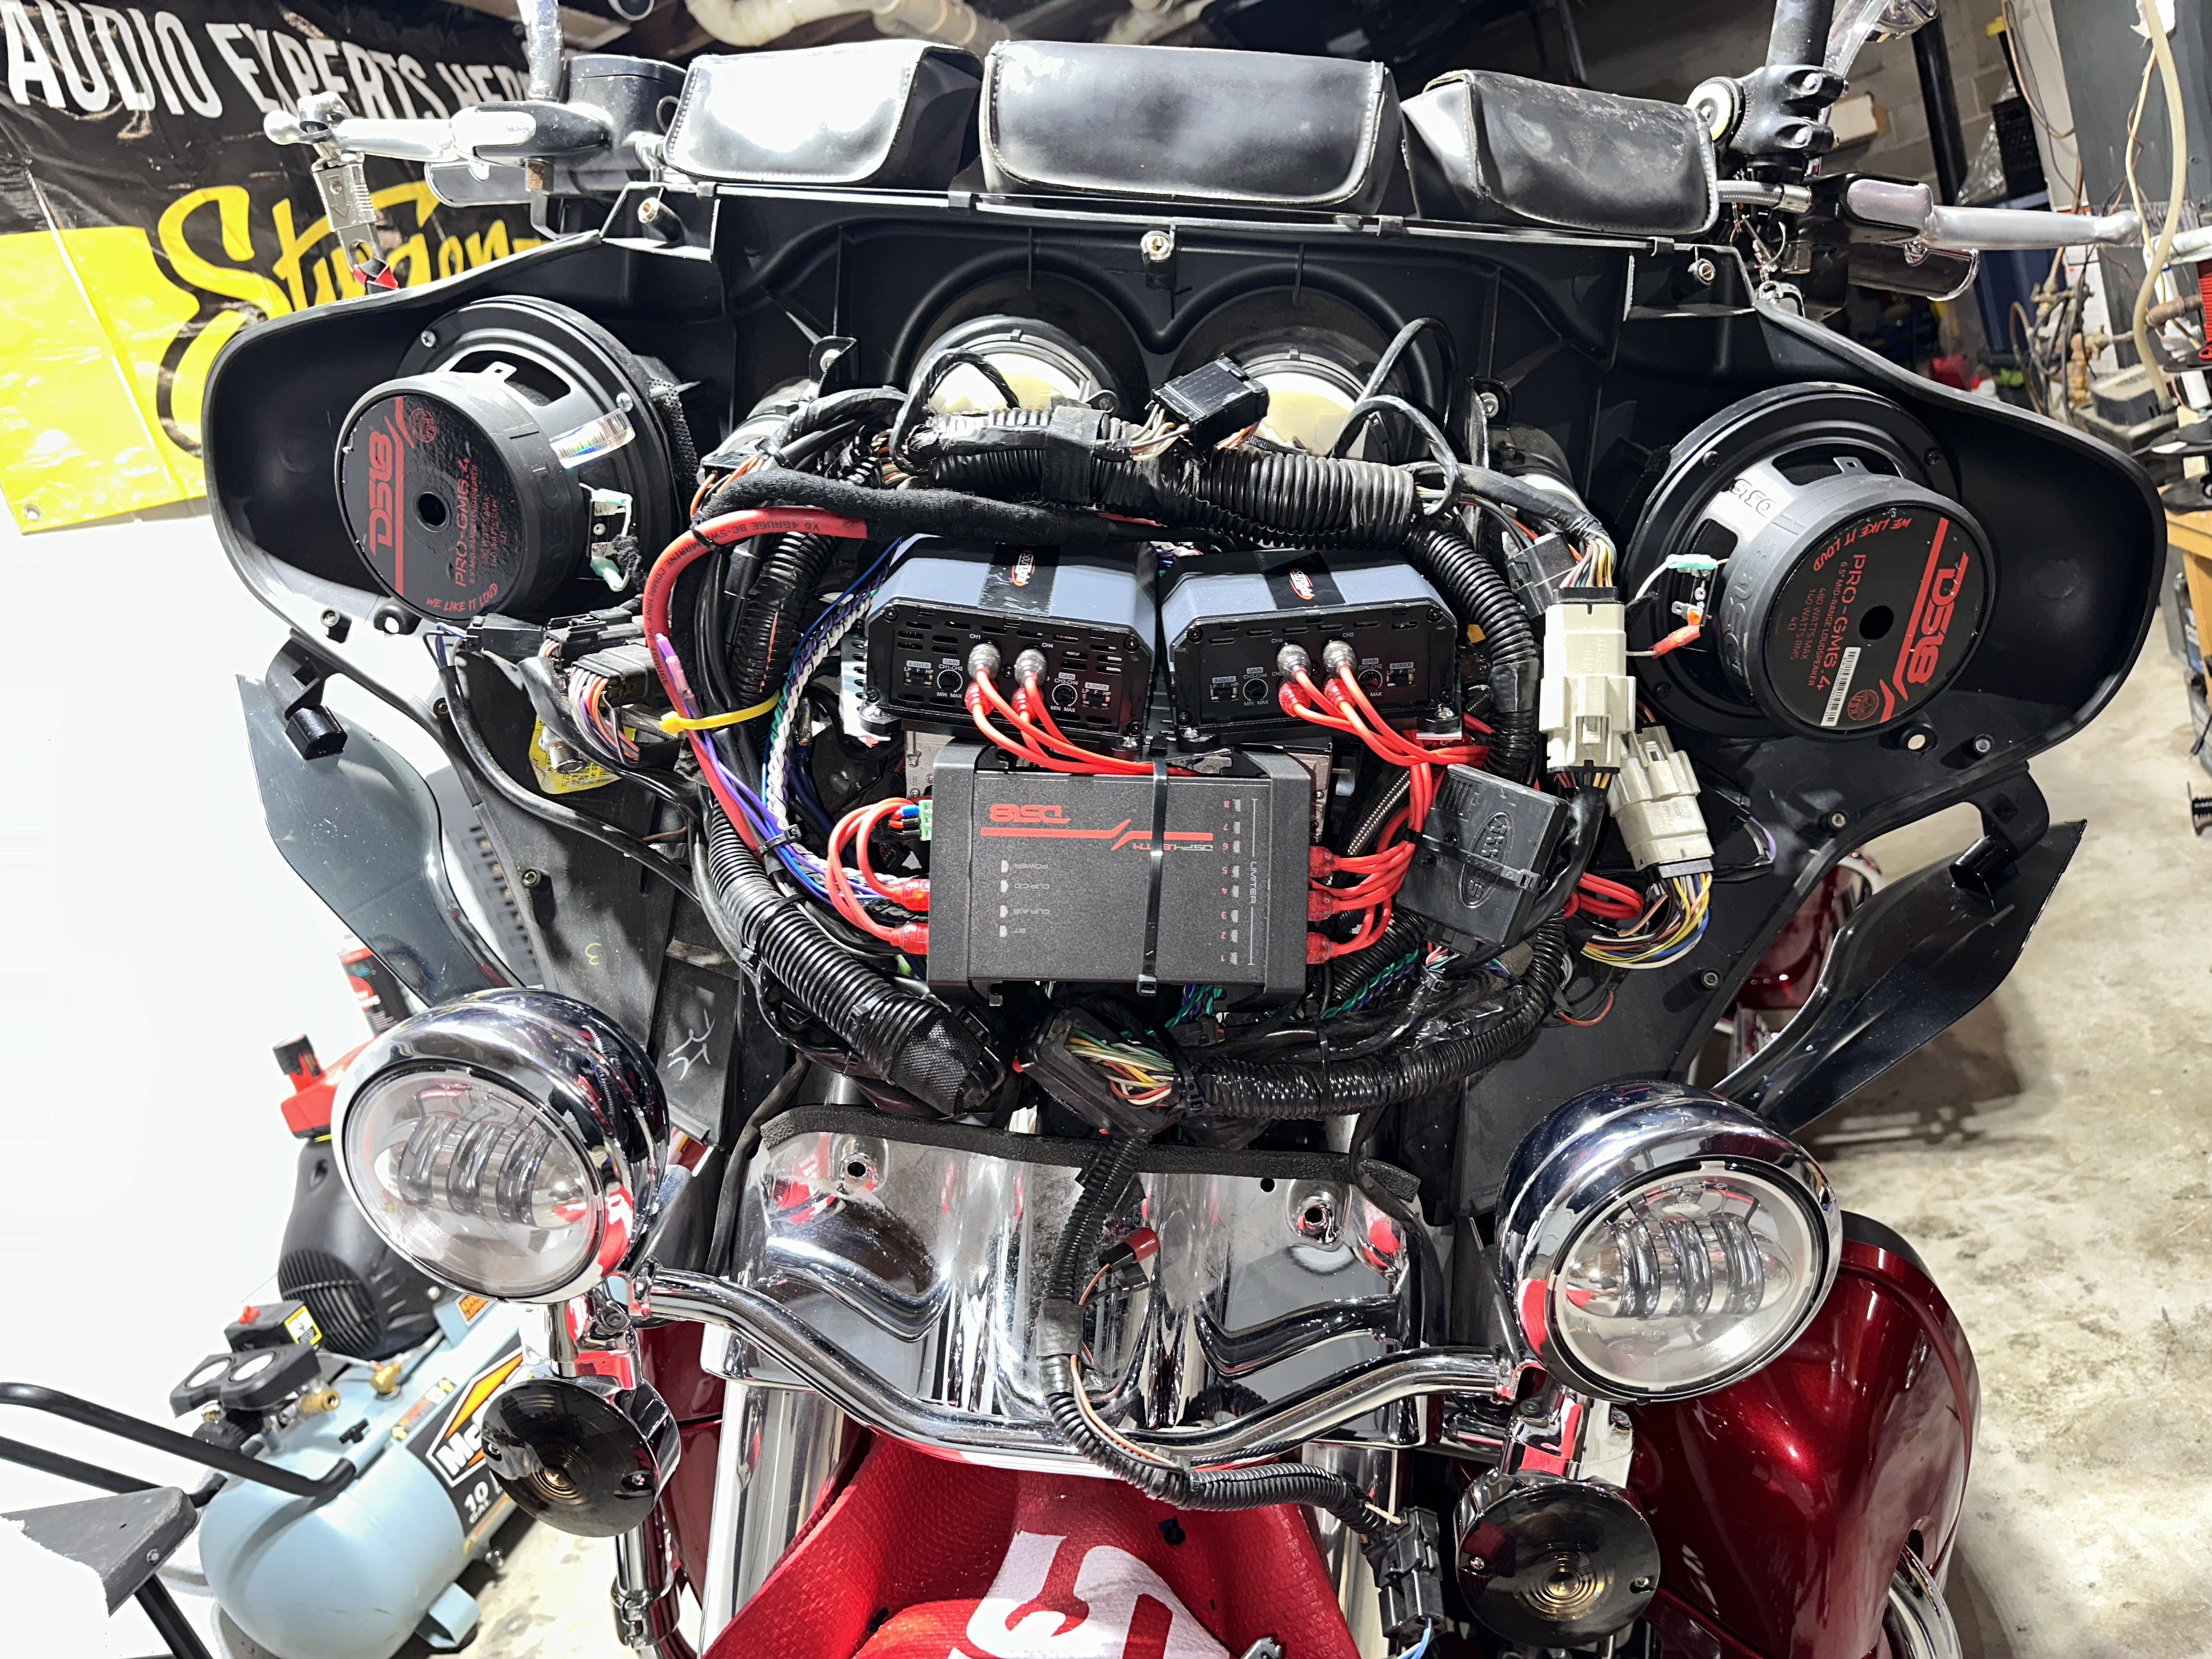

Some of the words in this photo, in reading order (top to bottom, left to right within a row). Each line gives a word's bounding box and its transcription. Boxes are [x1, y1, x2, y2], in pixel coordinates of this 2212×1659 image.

[0, 0, 223, 119] AUDIO
[206, 22, 450, 119] EXPERTS
[369, 431, 393, 556] DS18
[752, 520, 799, 530] 4GAUGE
[804, 522, 820, 532] V6
[1859, 518, 1891, 538] LIKE
[1890, 517, 1912, 529] WE
[1844, 529, 1857, 546] IT
[665, 540, 704, 568] MARINE
[1813, 538, 1841, 572] LOUD
[426, 597, 442, 608] WE
[443, 601, 466, 612] LIKE
[469, 598, 477, 611] IT
[479, 583, 498, 608] LOUD
[1805, 589, 1815, 606] 140
[1816, 587, 1826, 605] 480
[1825, 578, 1843, 628] MID-RANGE
[1798, 607, 1809, 637] WATTS
[1809, 607, 1820, 637] WATTS
[1817, 554, 1866, 691] PRO-GM6.4
[1906, 550, 1969, 684] DS18
[1790, 637, 1802, 660] RMS
[1800, 639, 1811, 660] MAX
[1807, 629, 1831, 686] LOUDSPEAKER
[650, 646, 669, 687] 4GAUGE
[938, 663, 963, 672] CH1-CH2
[989, 803, 1071, 824] DS18
[1223, 800, 1230, 809] 8
[1222, 842, 1229, 850] 6
[1222, 866, 1228, 874] 5
[1221, 887, 1227, 895] 4
[1249, 861, 1257, 904] LIMITER
[1221, 931, 1227, 940] 2
[1220, 955, 1226, 963] 1
[464, 1481, 489, 1511] 10
